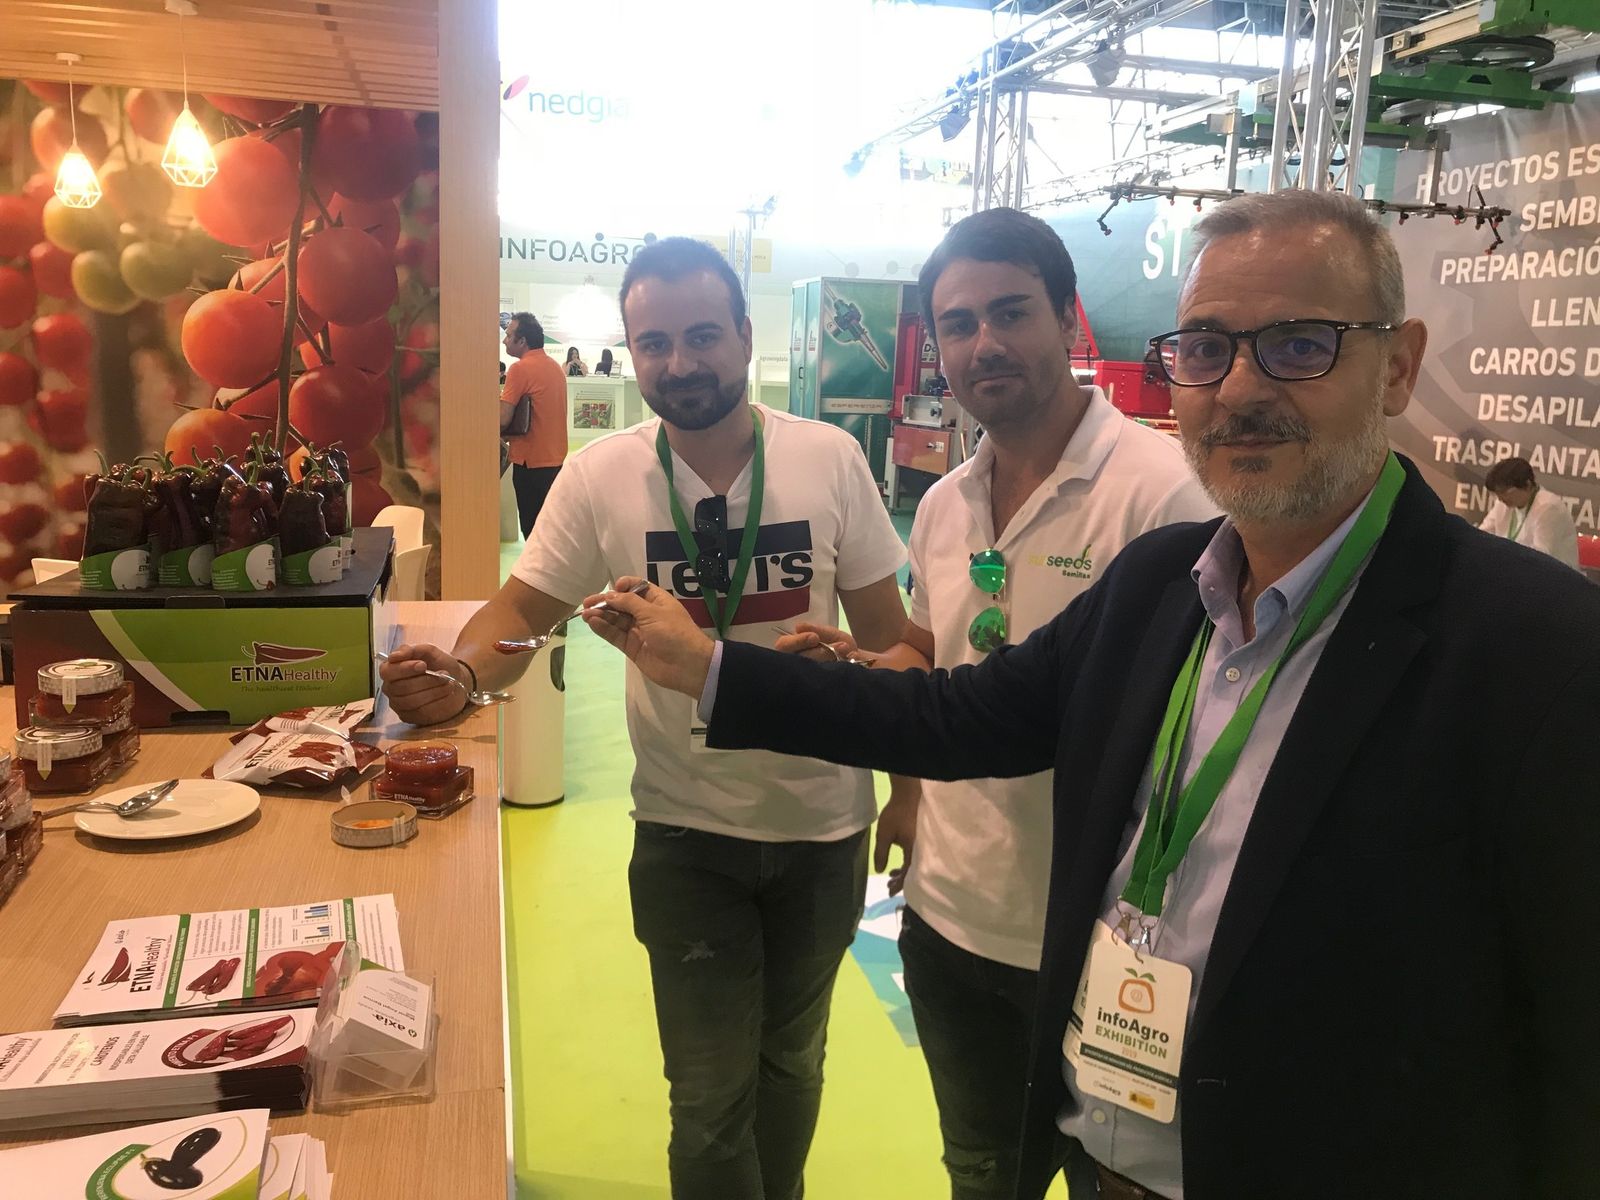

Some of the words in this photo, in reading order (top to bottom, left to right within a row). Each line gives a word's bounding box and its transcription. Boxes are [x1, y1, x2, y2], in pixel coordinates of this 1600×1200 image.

[1568, 143, 1600, 177] ES
[1520, 195, 1600, 232] SEMB
[1469, 347, 1577, 376] CARROS
[231, 665, 339, 683] ETNAHealthy
[1095, 1025, 1168, 1060] EXHIBITION
[1097, 1006, 1170, 1045] infoAgro
